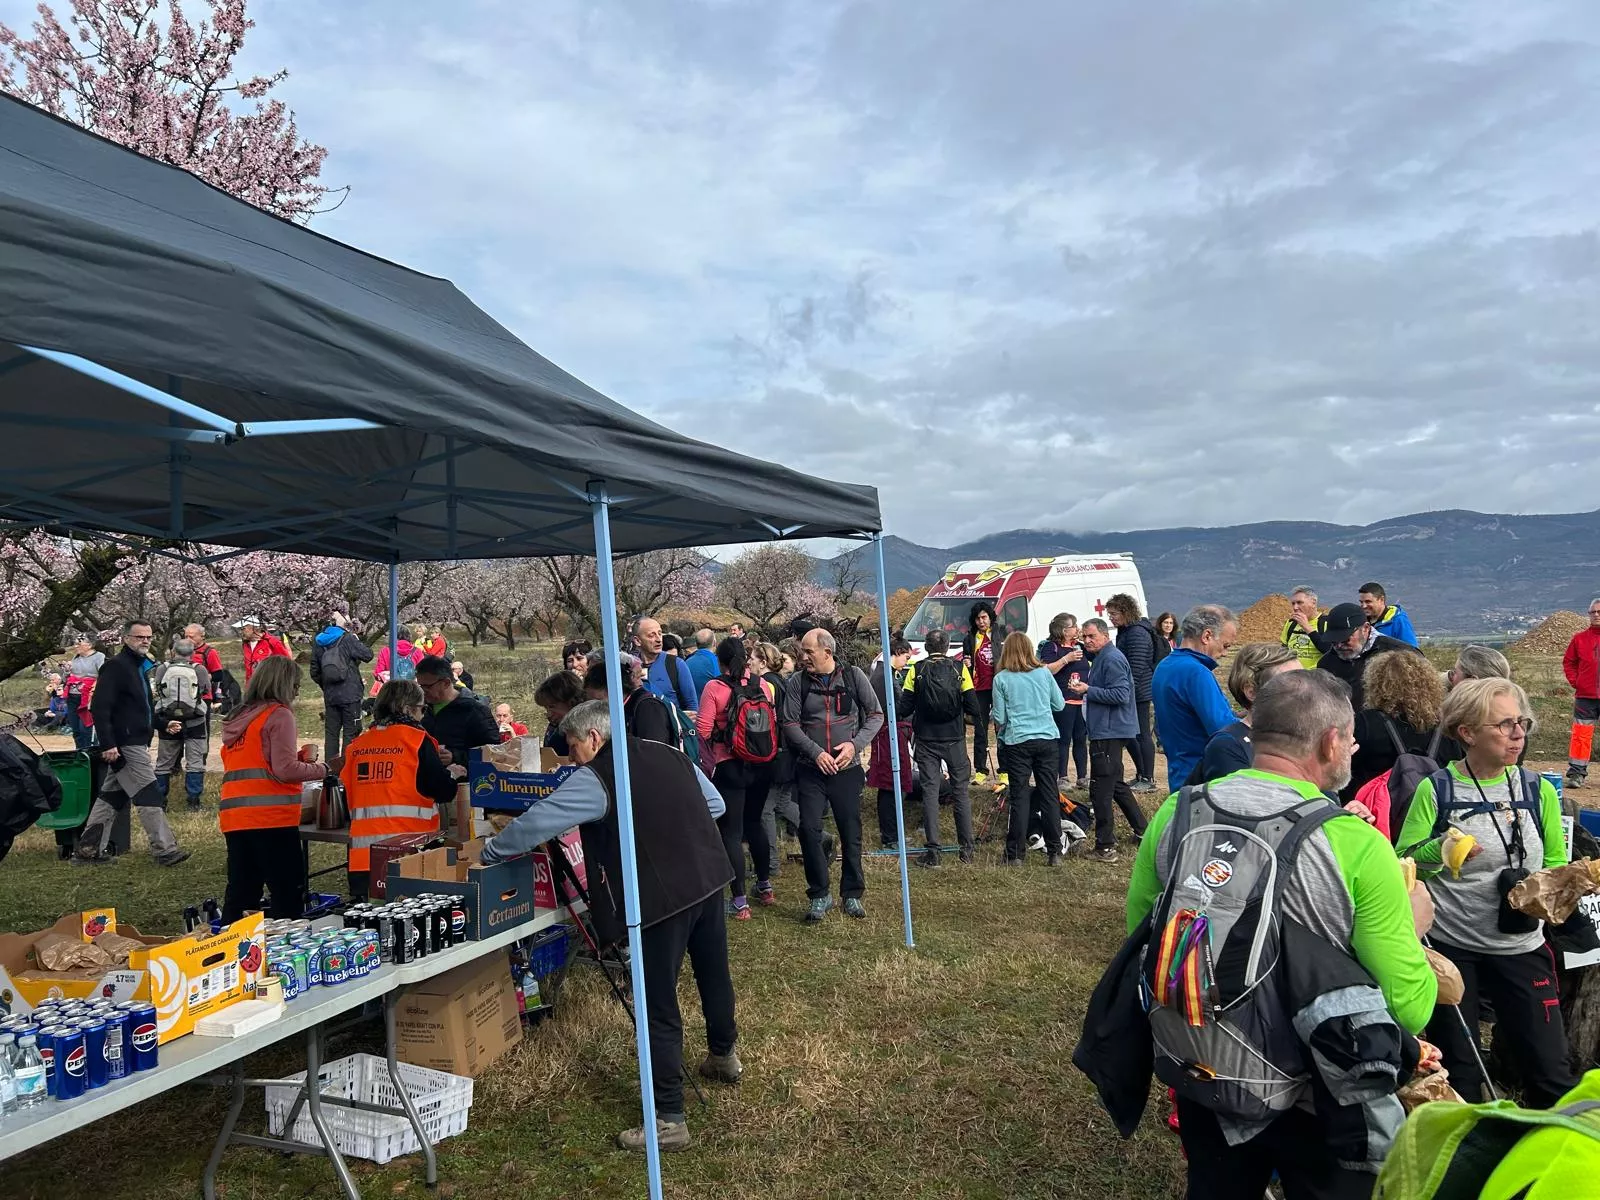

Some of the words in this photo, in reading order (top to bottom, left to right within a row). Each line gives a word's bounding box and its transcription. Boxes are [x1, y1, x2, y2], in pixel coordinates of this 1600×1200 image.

[1056, 563, 1096, 574] AMBULANCIA
[115, 974, 125, 983] 17
[242, 980, 257, 993] Nat
[133, 1032, 157, 1042] PEPS
